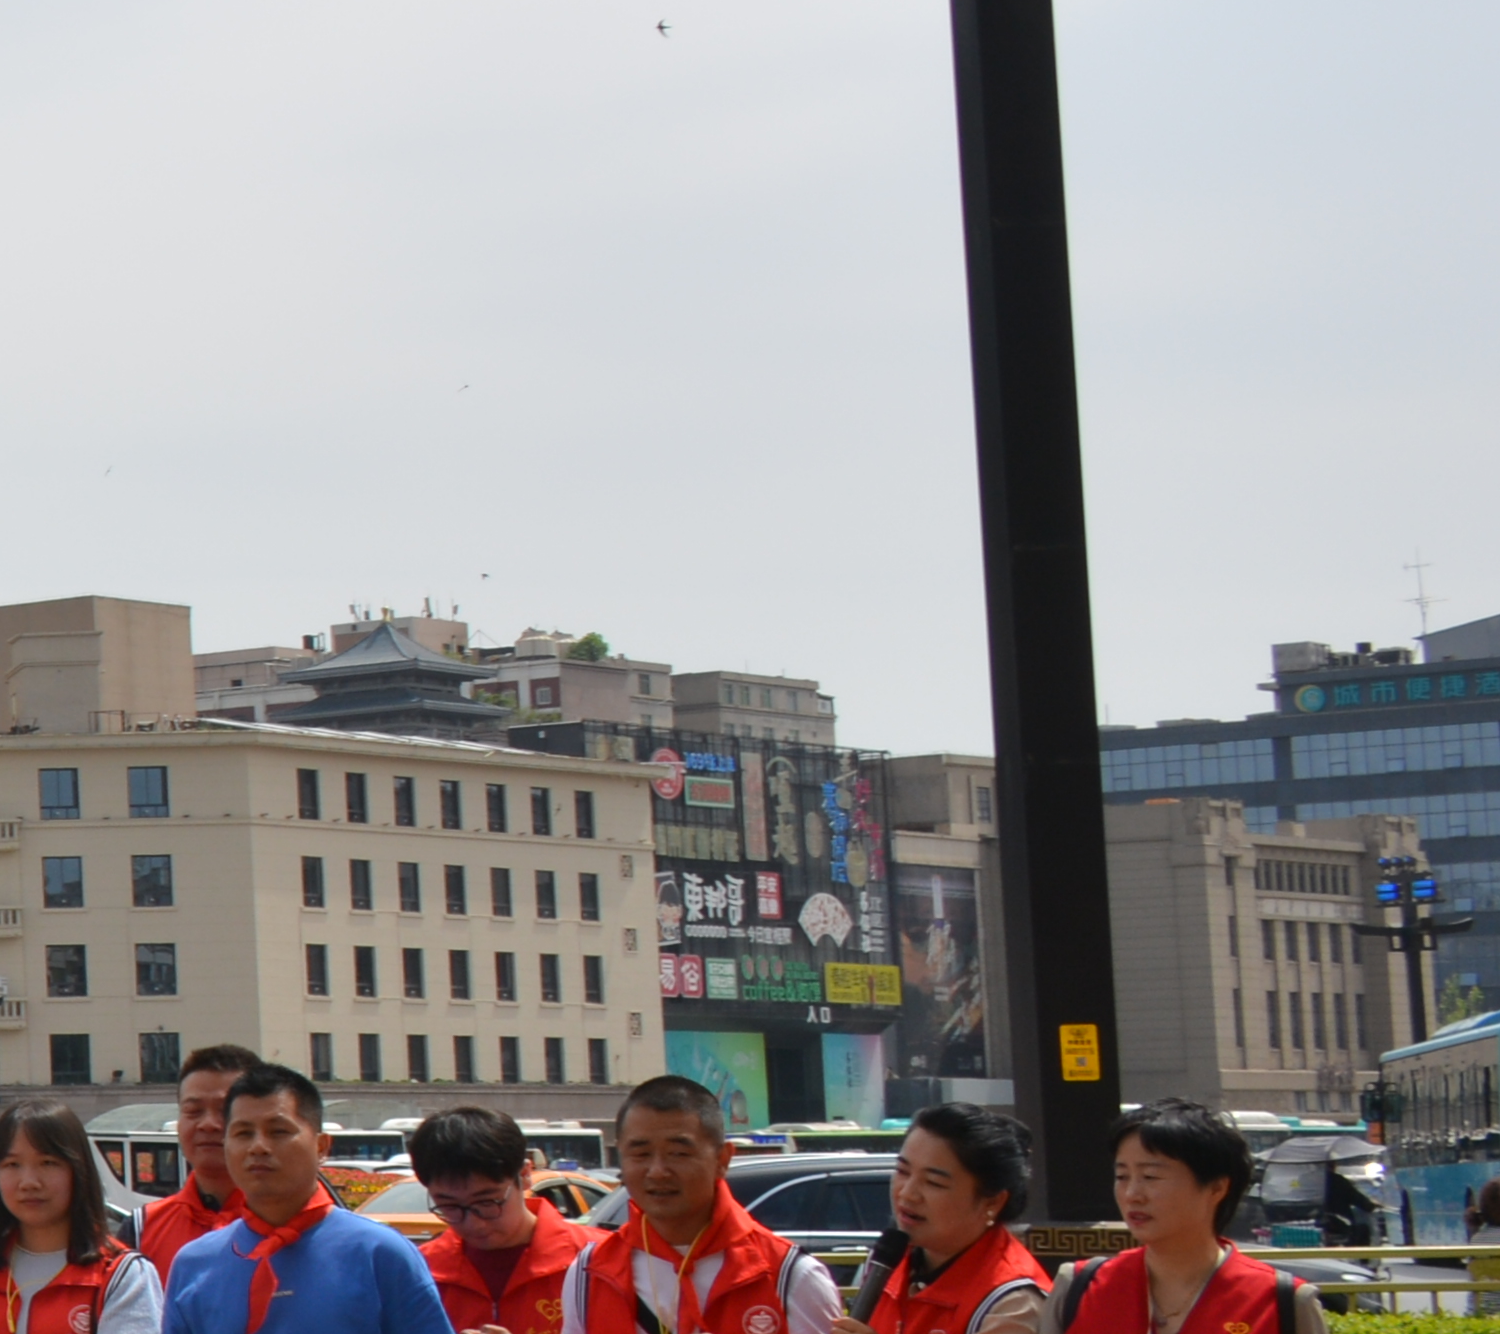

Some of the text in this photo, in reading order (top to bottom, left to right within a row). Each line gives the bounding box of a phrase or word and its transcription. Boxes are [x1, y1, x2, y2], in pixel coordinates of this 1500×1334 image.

[1333, 671, 1500, 707] 城市便捷酒
